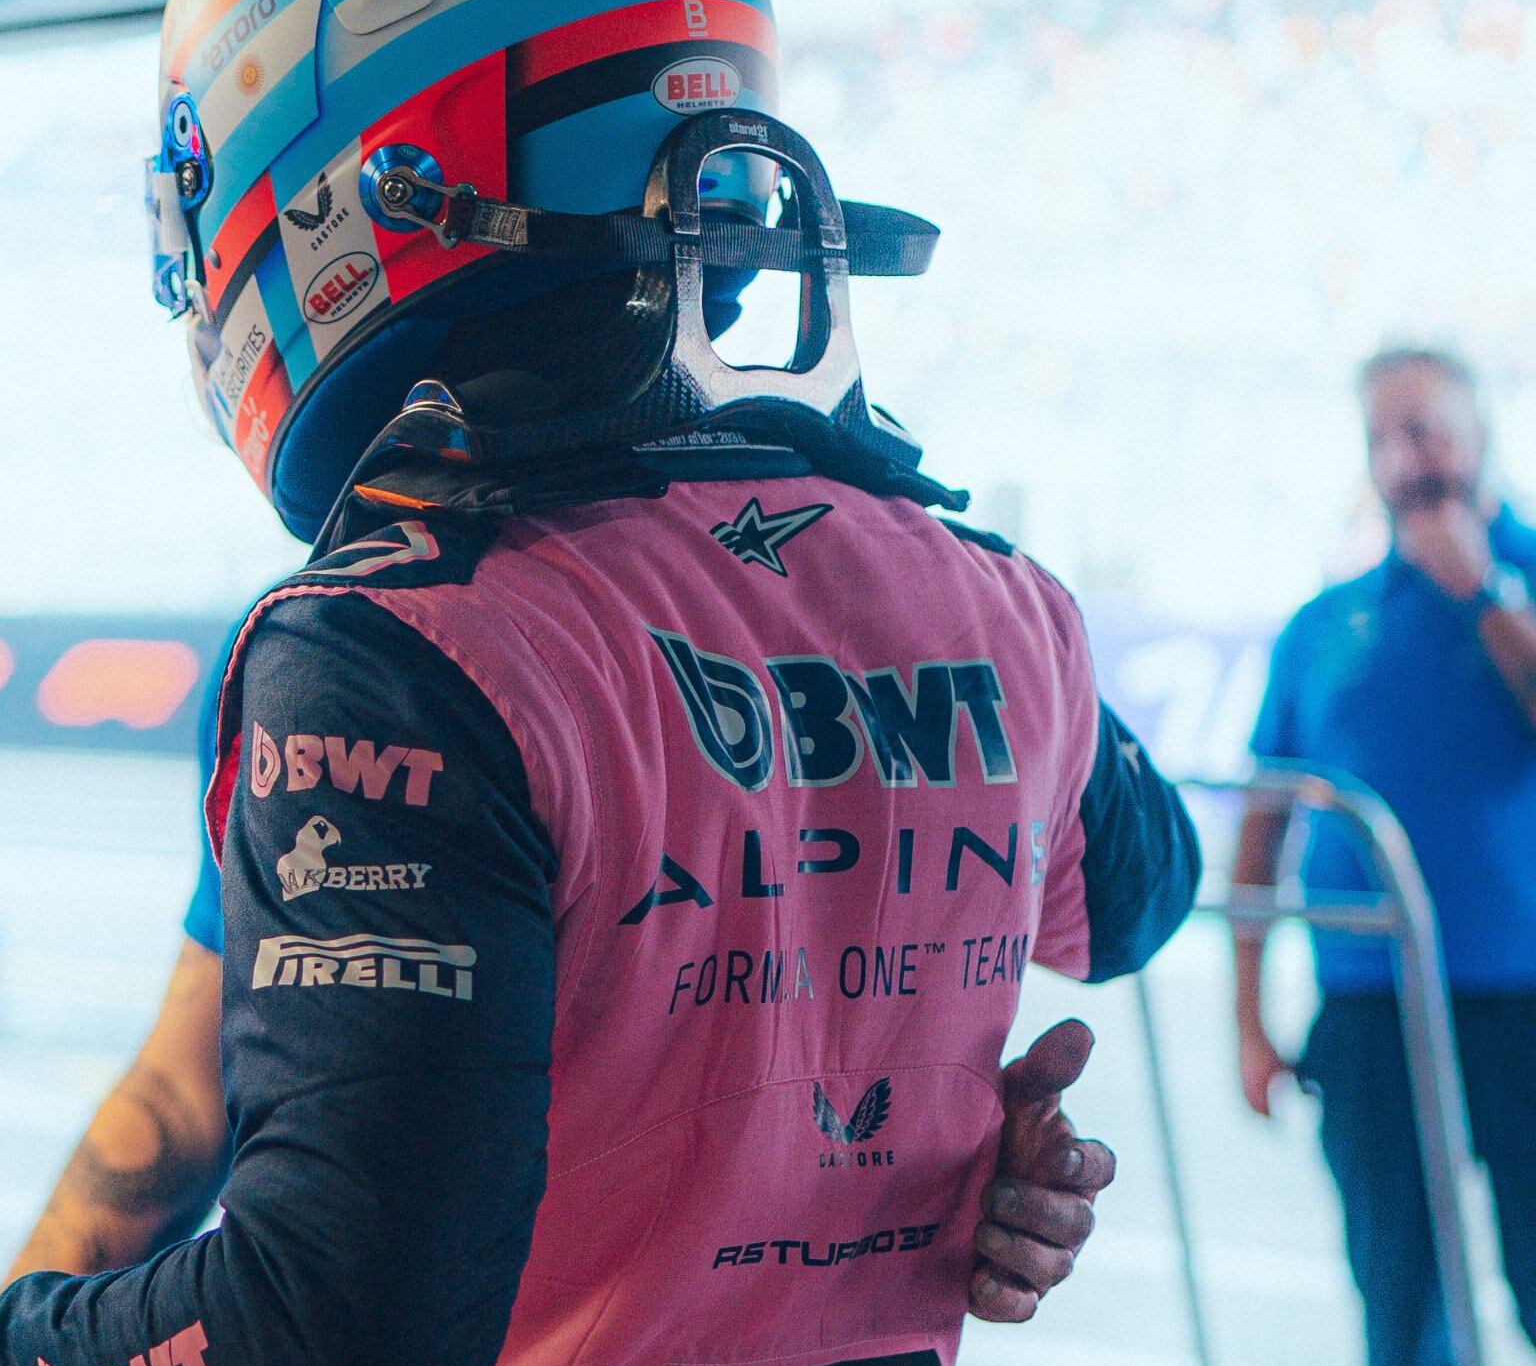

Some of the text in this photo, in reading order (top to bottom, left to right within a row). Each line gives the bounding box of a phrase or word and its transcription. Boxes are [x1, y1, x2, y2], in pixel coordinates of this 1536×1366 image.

[667, 72, 731, 101] BELL
[311, 207, 350, 251] CASTORE
[308, 263, 370, 317] BELL
[785, 656, 1017, 788] BWT
[285, 734, 444, 806] BWT
[616, 819, 1046, 926] ALPINE
[252, 933, 478, 1001] PIRELLI
